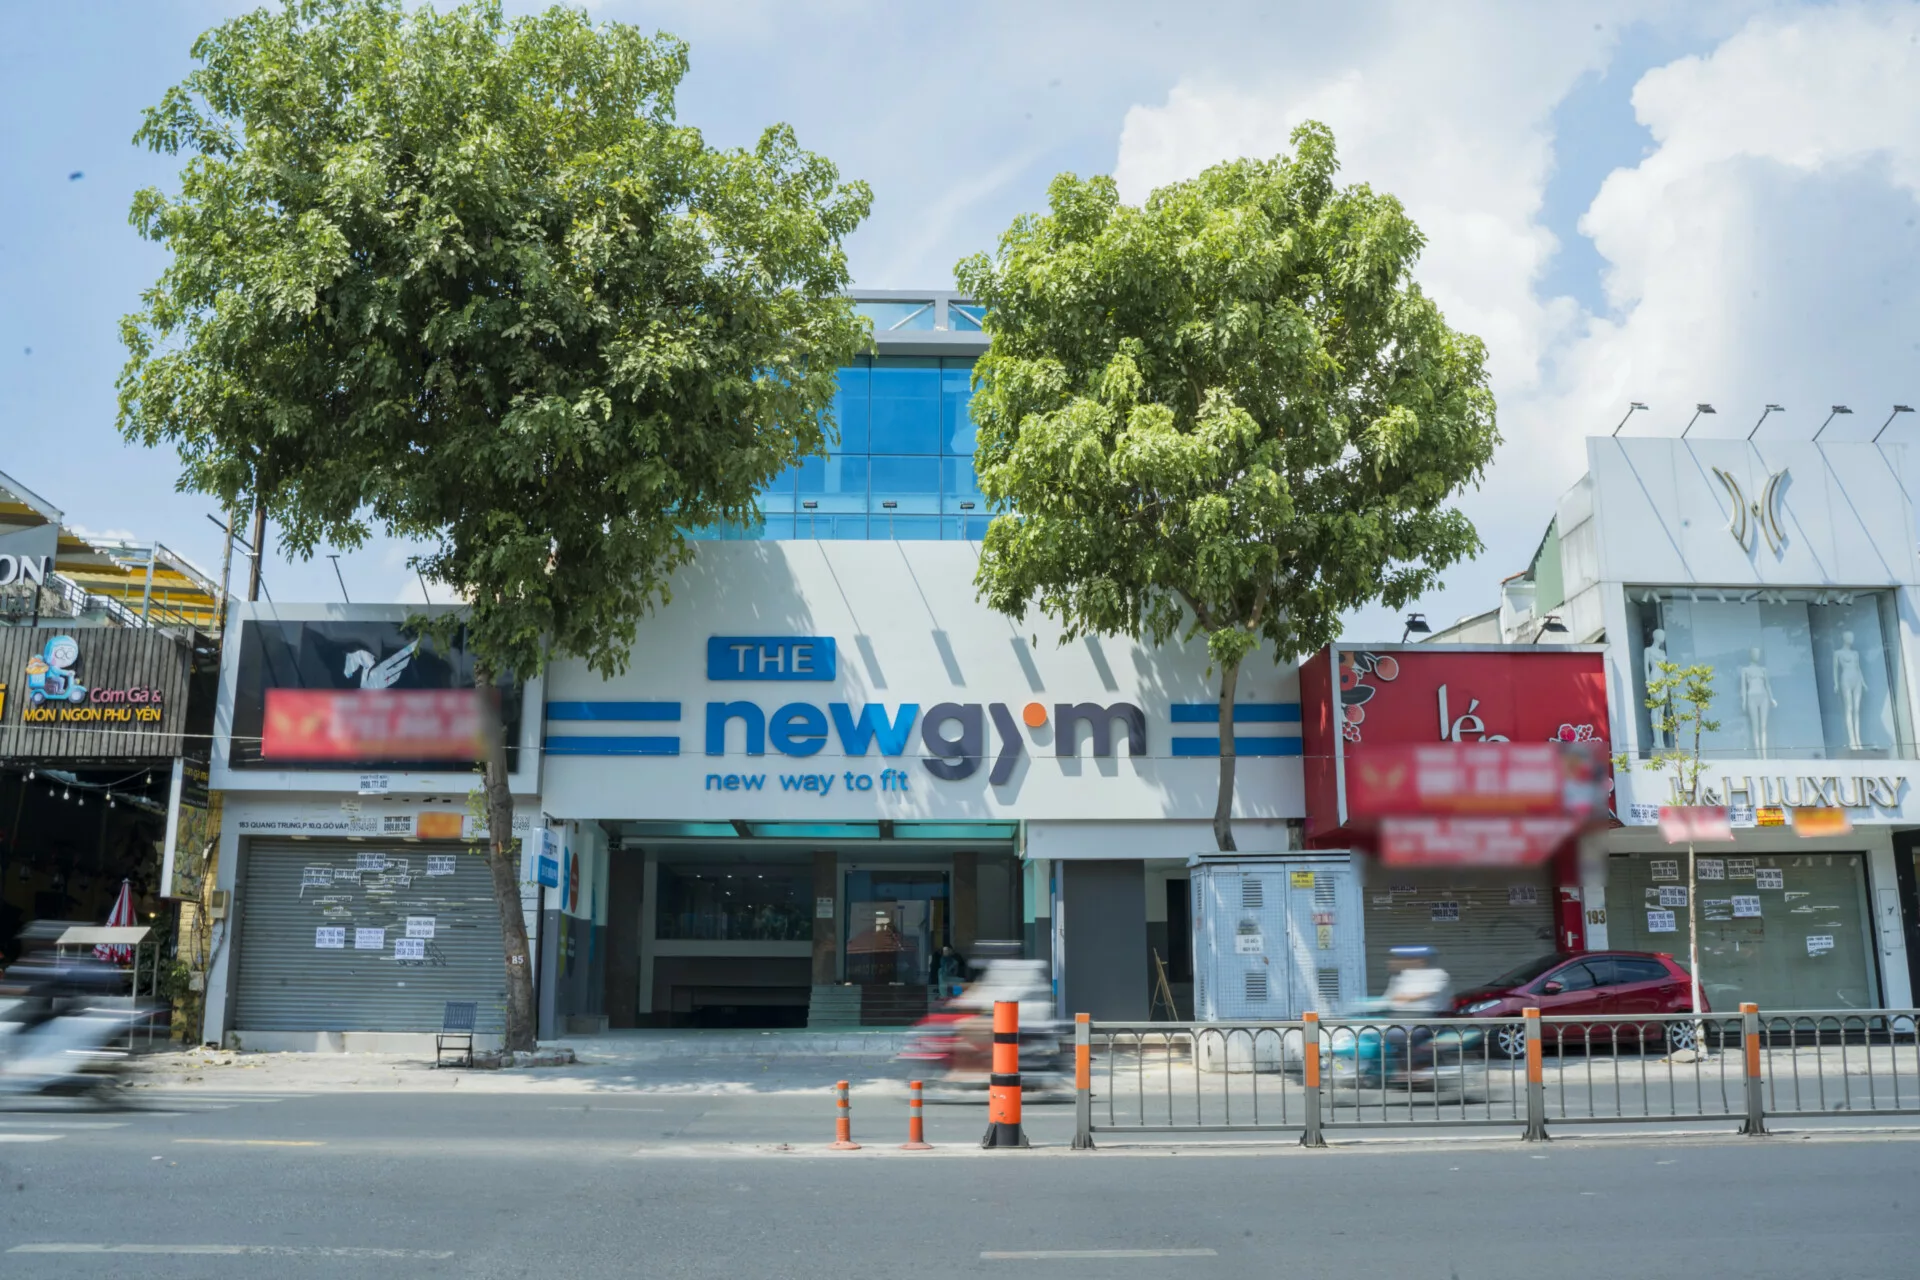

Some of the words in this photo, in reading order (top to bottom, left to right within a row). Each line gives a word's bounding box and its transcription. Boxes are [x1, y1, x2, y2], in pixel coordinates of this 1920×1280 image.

[730, 645, 814, 674] THE
[90, 687, 124, 703] Cơm
[152, 691, 162, 703] &
[23, 706, 56, 721] MÓN
[60, 708, 101, 721] NGON
[103, 704, 131, 721] PHÚ
[135, 706, 161, 721] YÊN
[706, 701, 1147, 787] newgym
[706, 773, 766, 791] new
[780, 774, 833, 797] way
[843, 771, 873, 791] to
[879, 769, 909, 792] fit
[1702, 787, 1721, 807] &
[1722, 777, 1755, 807] H
[1760, 777, 1906, 808] LUXURY
[1586, 910, 1606, 924] 193
